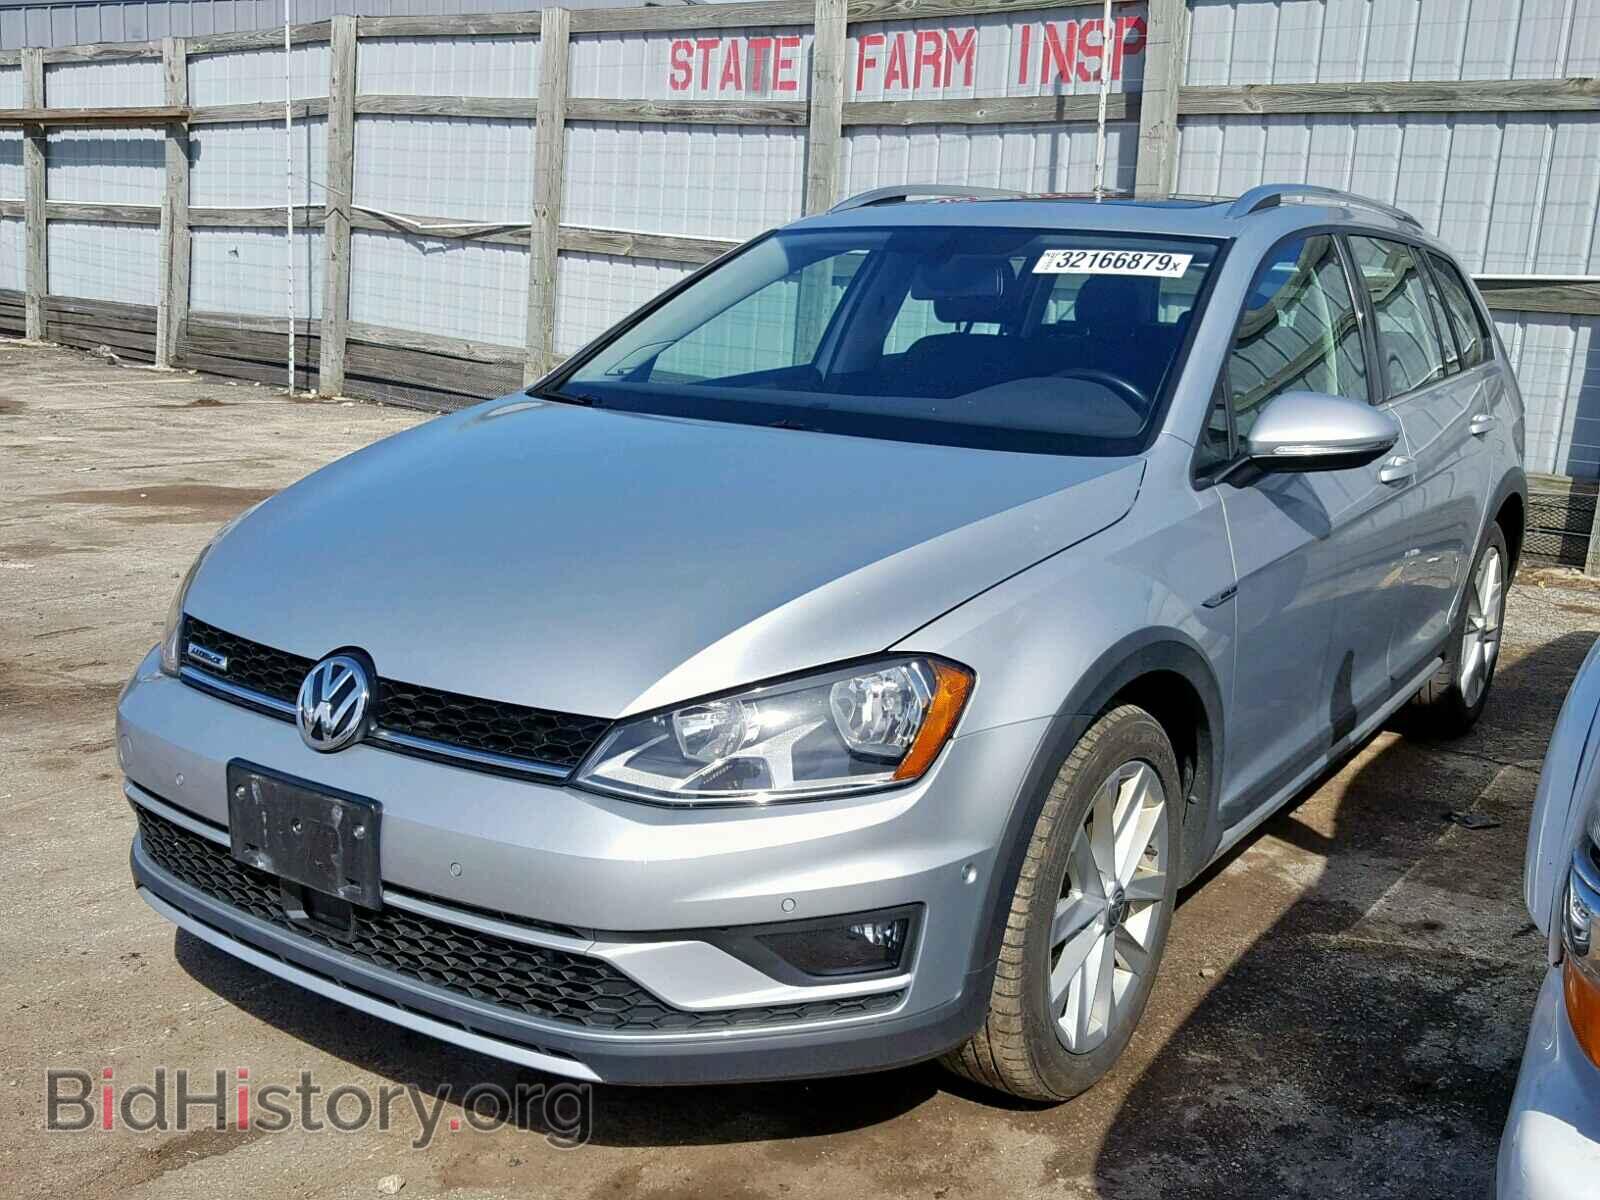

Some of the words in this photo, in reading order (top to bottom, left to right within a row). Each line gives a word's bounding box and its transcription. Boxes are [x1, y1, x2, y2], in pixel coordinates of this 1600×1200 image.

[669, 36, 801, 91] STATE
[856, 27, 978, 91] FARM
[1018, 16, 1147, 85] INSP
